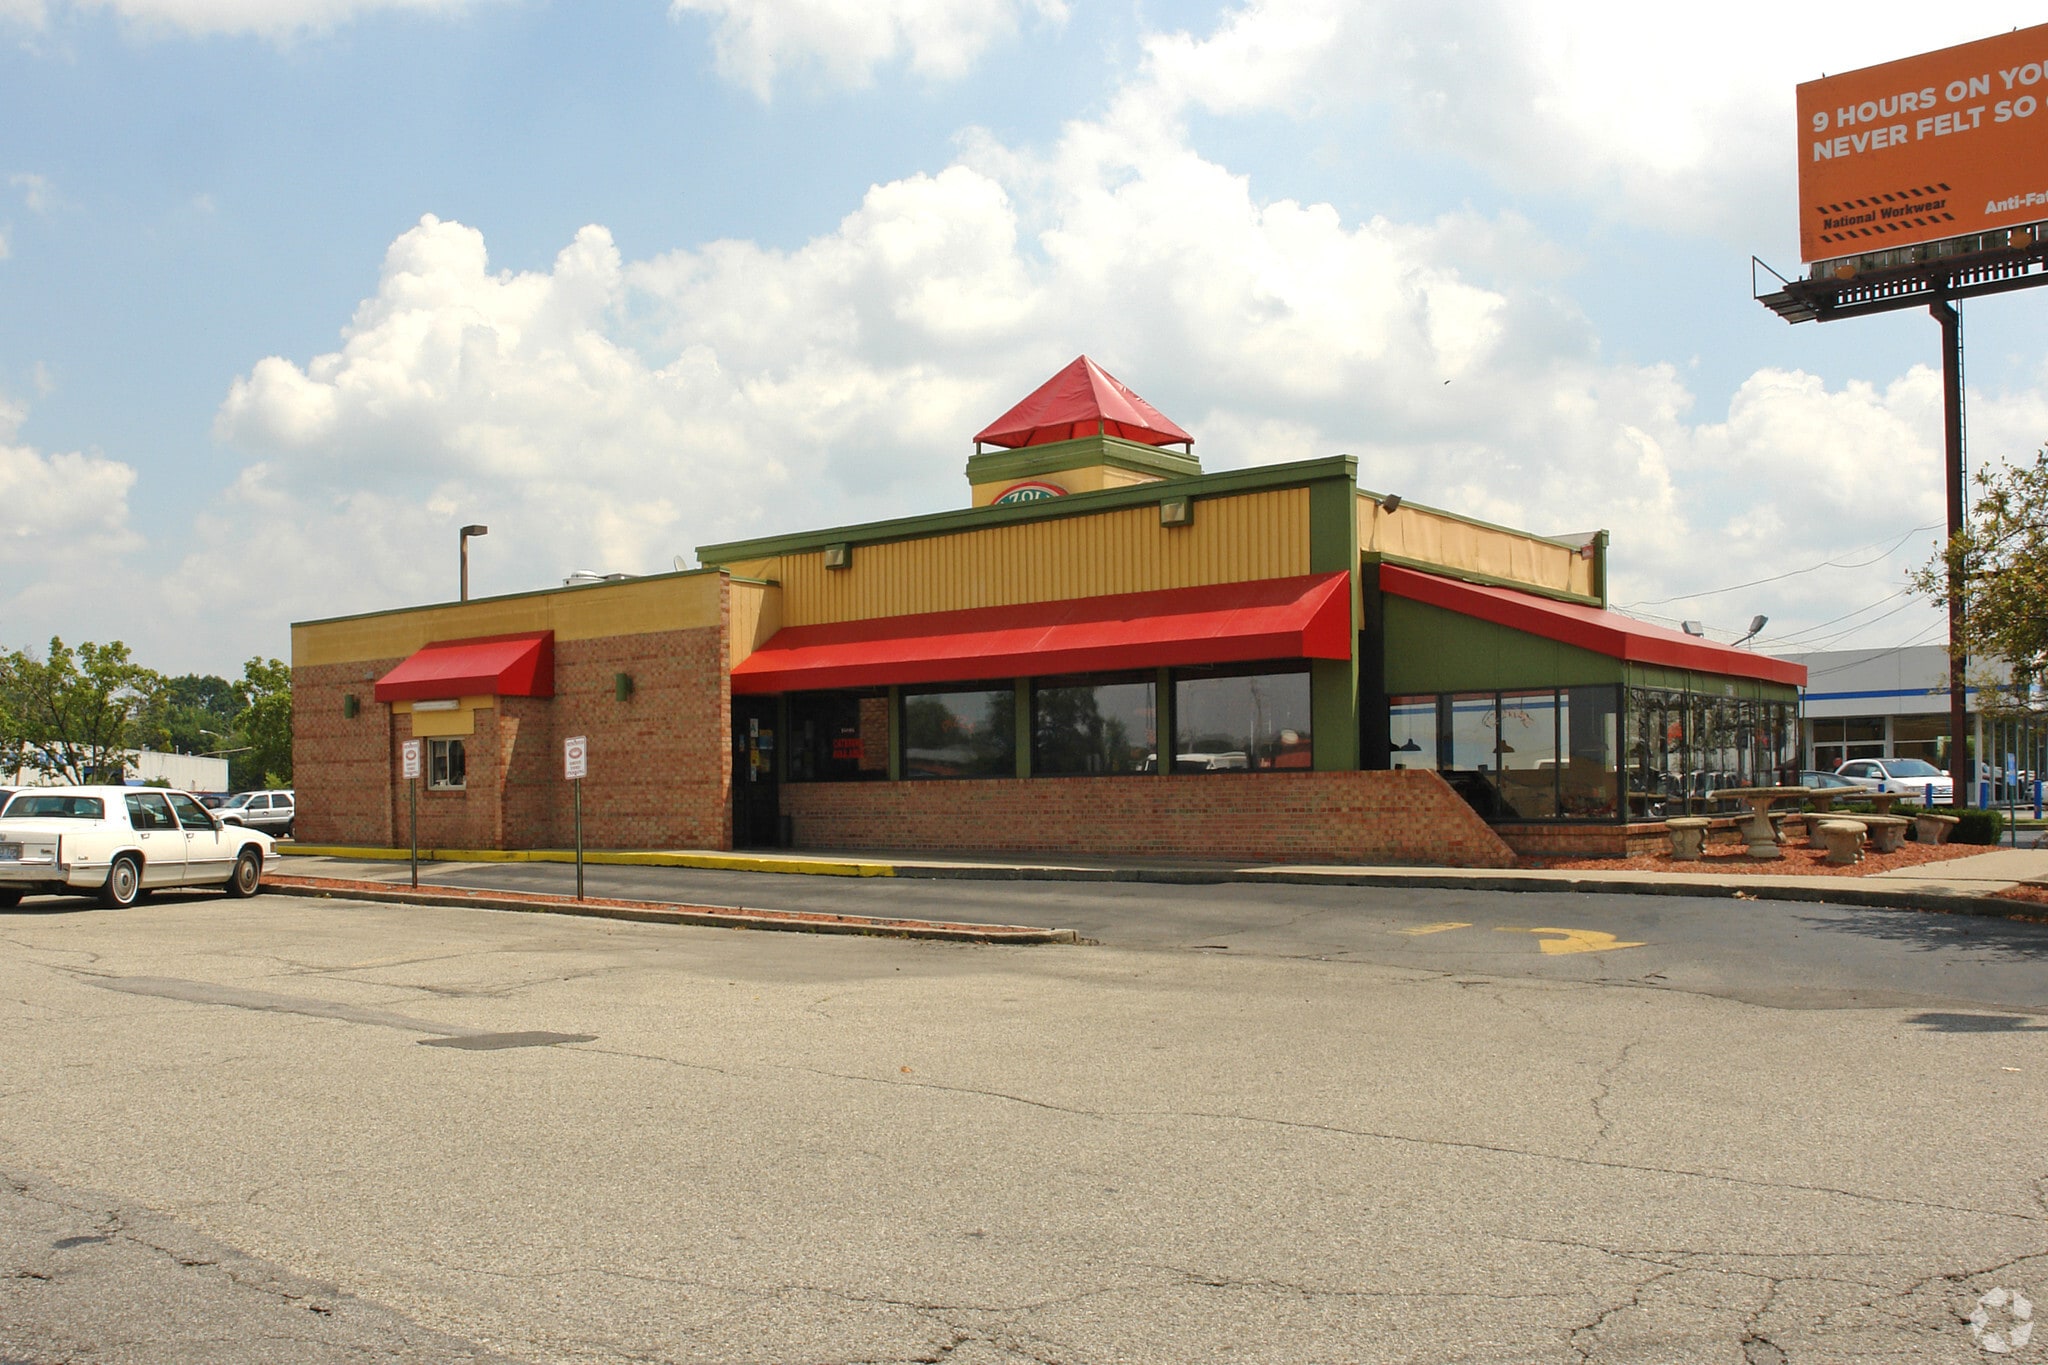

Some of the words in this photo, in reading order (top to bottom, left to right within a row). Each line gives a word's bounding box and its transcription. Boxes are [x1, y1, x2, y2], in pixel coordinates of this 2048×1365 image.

[1812, 111, 1829, 132] 9
[1837, 87, 1936, 127] HOURS
[1944, 74, 1989, 102] ON
[1813, 124, 1907, 162] NEVER
[1916, 106, 1985, 140] FELT
[1994, 96, 2037, 122] SO
[1823, 210, 1876, 230] National
[1880, 199, 1946, 219] Workwear
